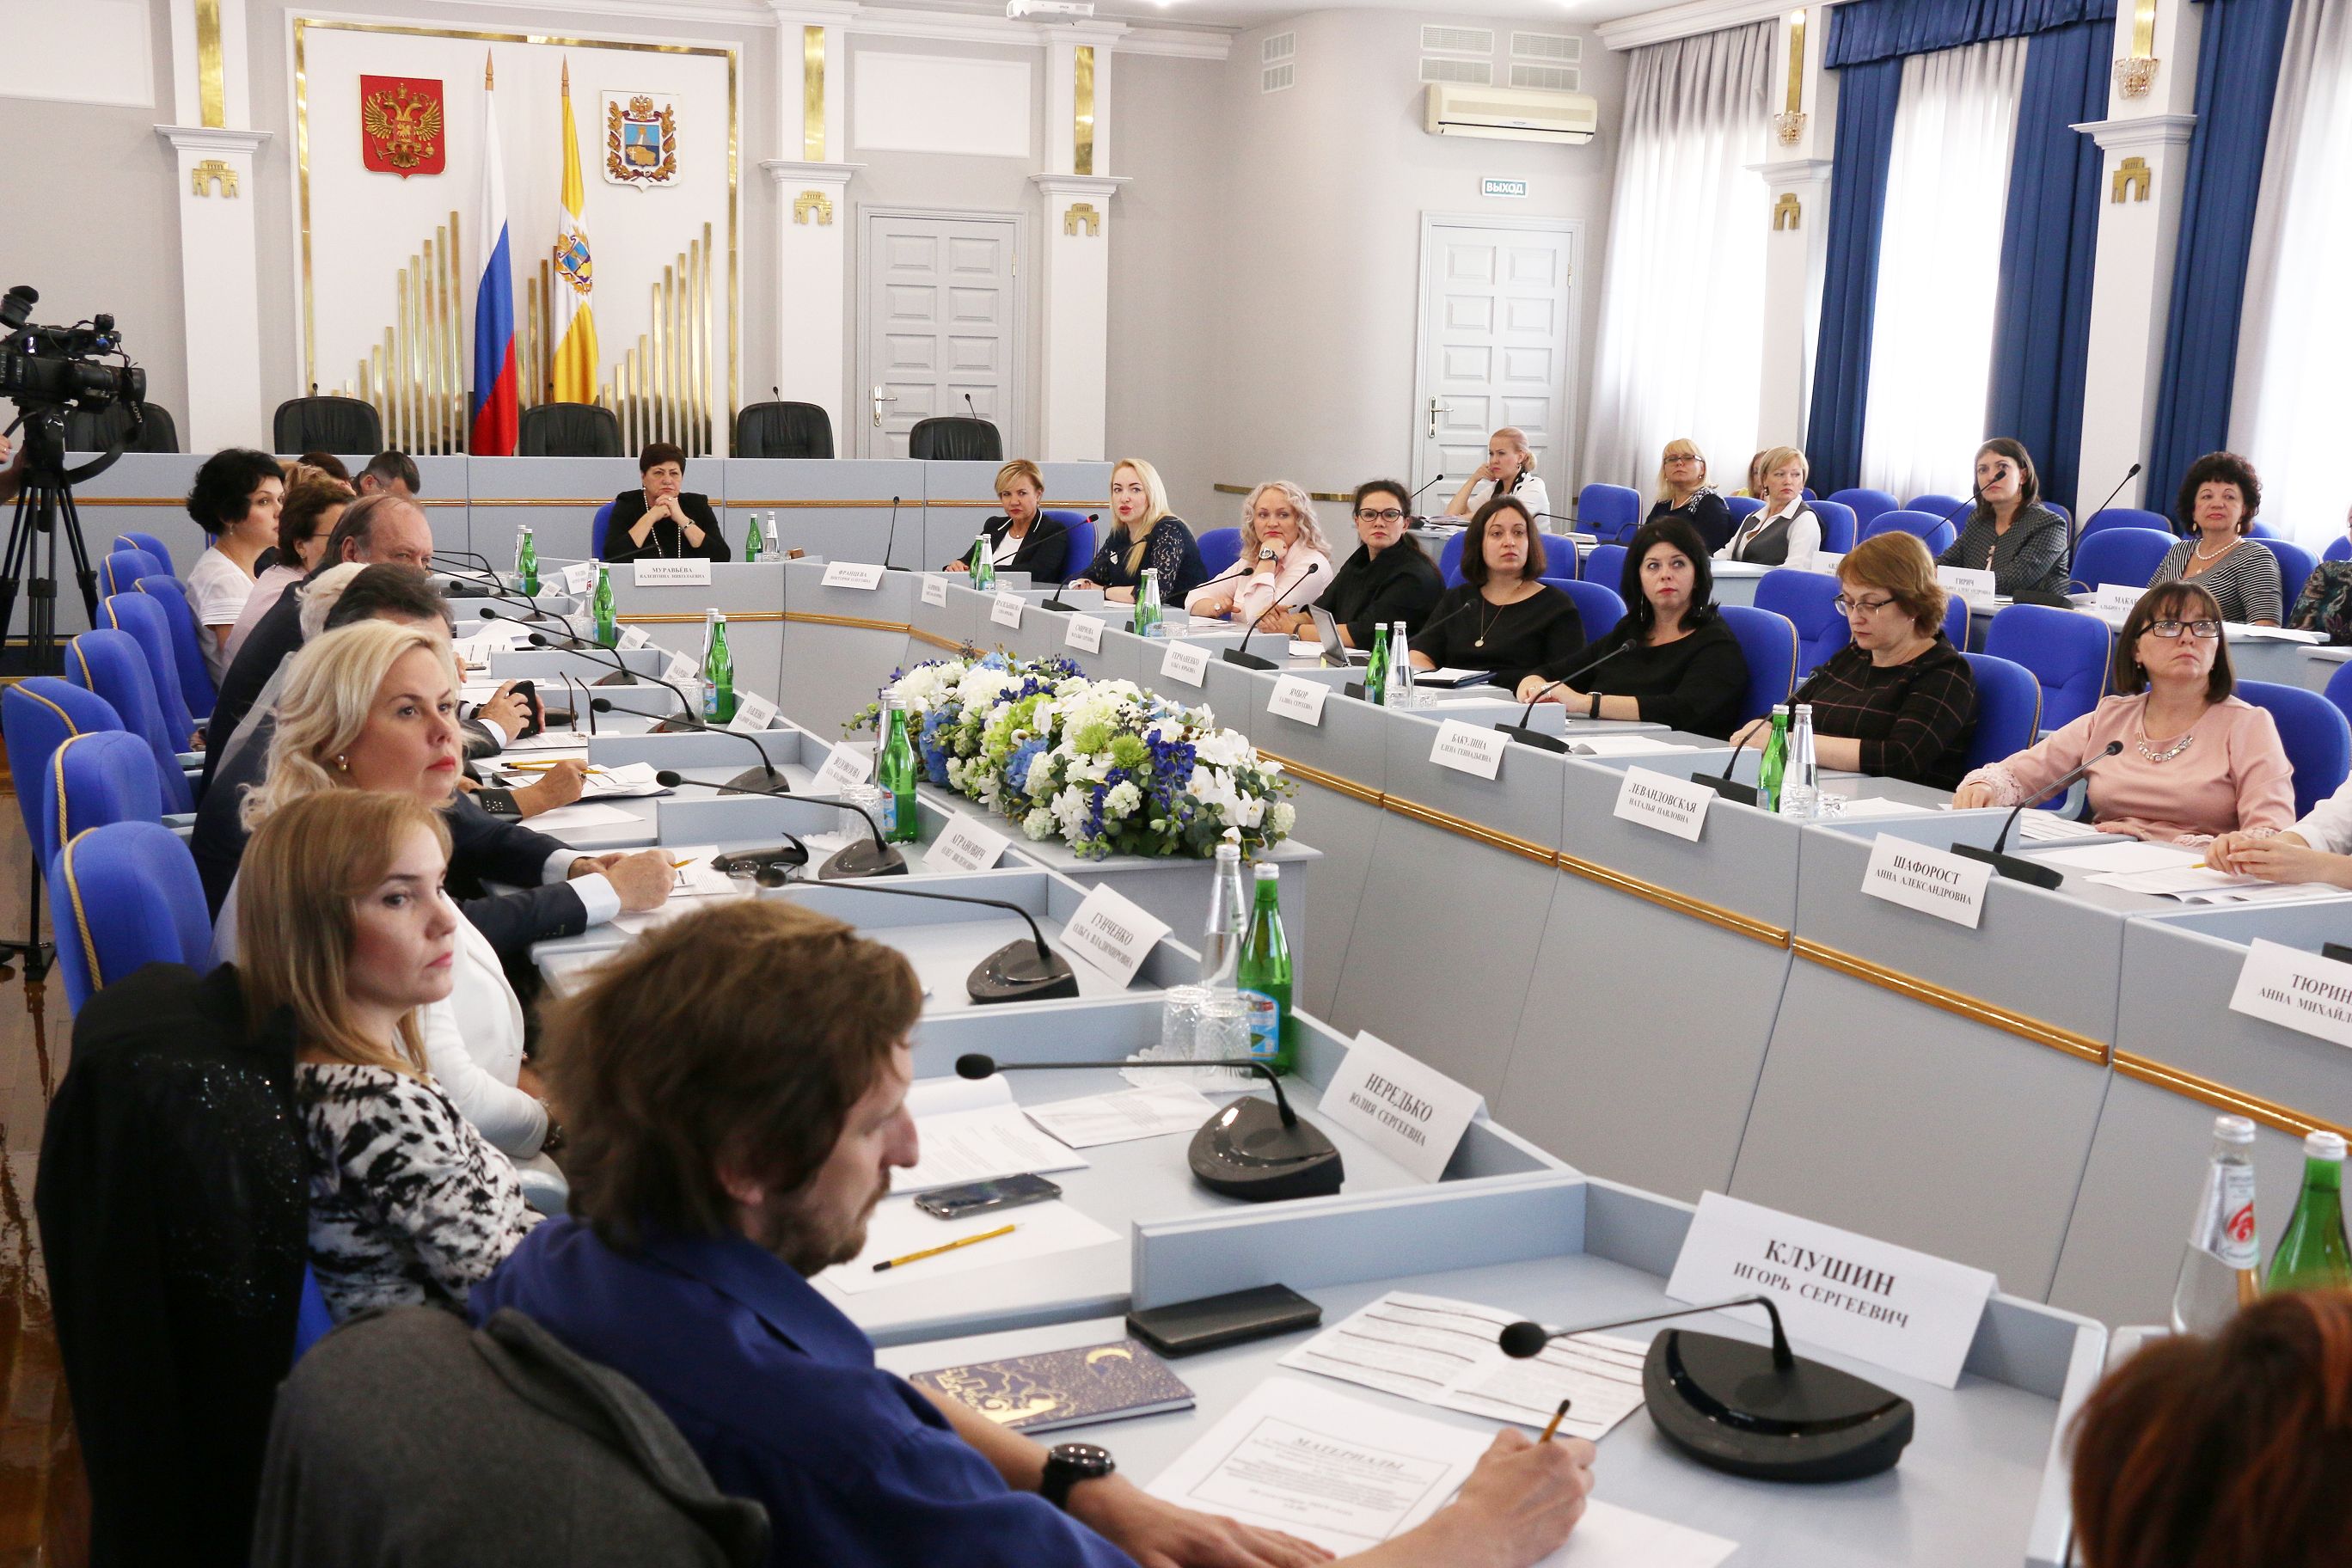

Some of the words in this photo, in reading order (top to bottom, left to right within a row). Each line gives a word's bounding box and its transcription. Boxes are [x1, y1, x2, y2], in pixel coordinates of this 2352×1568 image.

[1486, 181, 1523, 194] ВЫХОД
[131, 401, 143, 423] SONY
[1955, 577, 1975, 586] ГИРИЧ
[1289, 688, 1309, 699] ЯМБОР
[1440, 744, 1456, 754] ЕЛЕНА
[1457, 747, 1491, 763] ГЕННАДЬЕВНА
[1451, 733, 1487, 750] БАКУЛИНА
[1629, 782, 1697, 813] ЛЕВАНДОВСКАЯ
[1629, 797, 1656, 812] НАТАЛЬЯ
[1657, 808, 1688, 824] ПАВЛОВНА
[952, 832, 987, 861] АГРАНОВИЧ
[1893, 854, 1961, 885] ШАФОРОСТ
[1875, 868, 1897, 883] АННА
[1901, 875, 1972, 905] АЛЕКСАНДРОВНА
[1091, 912, 1135, 946] ГУНЧЕНКО
[1073, 922, 1091, 940] ОЛЬГА
[1090, 934, 1134, 969] ВЛАДИМИРОВНА
[2258, 987, 2291, 1005] АННА
[2297, 997, 2352, 1024] МИХАЙЛ
[2292, 973, 2352, 1007] ТЮРИН
[1364, 1072, 1433, 1124] НЕРЕДЬКО
[1349, 1092, 1377, 1117] ЮЛИЯ
[1378, 1108, 1427, 1148] СЕРГЕЕВНА
[1764, 1239, 1896, 1296] КЛУШИН
[1733, 1261, 1792, 1292] ИГОРЬ
[1799, 1282, 1910, 1329] СЕРГЕЕВИЧ
